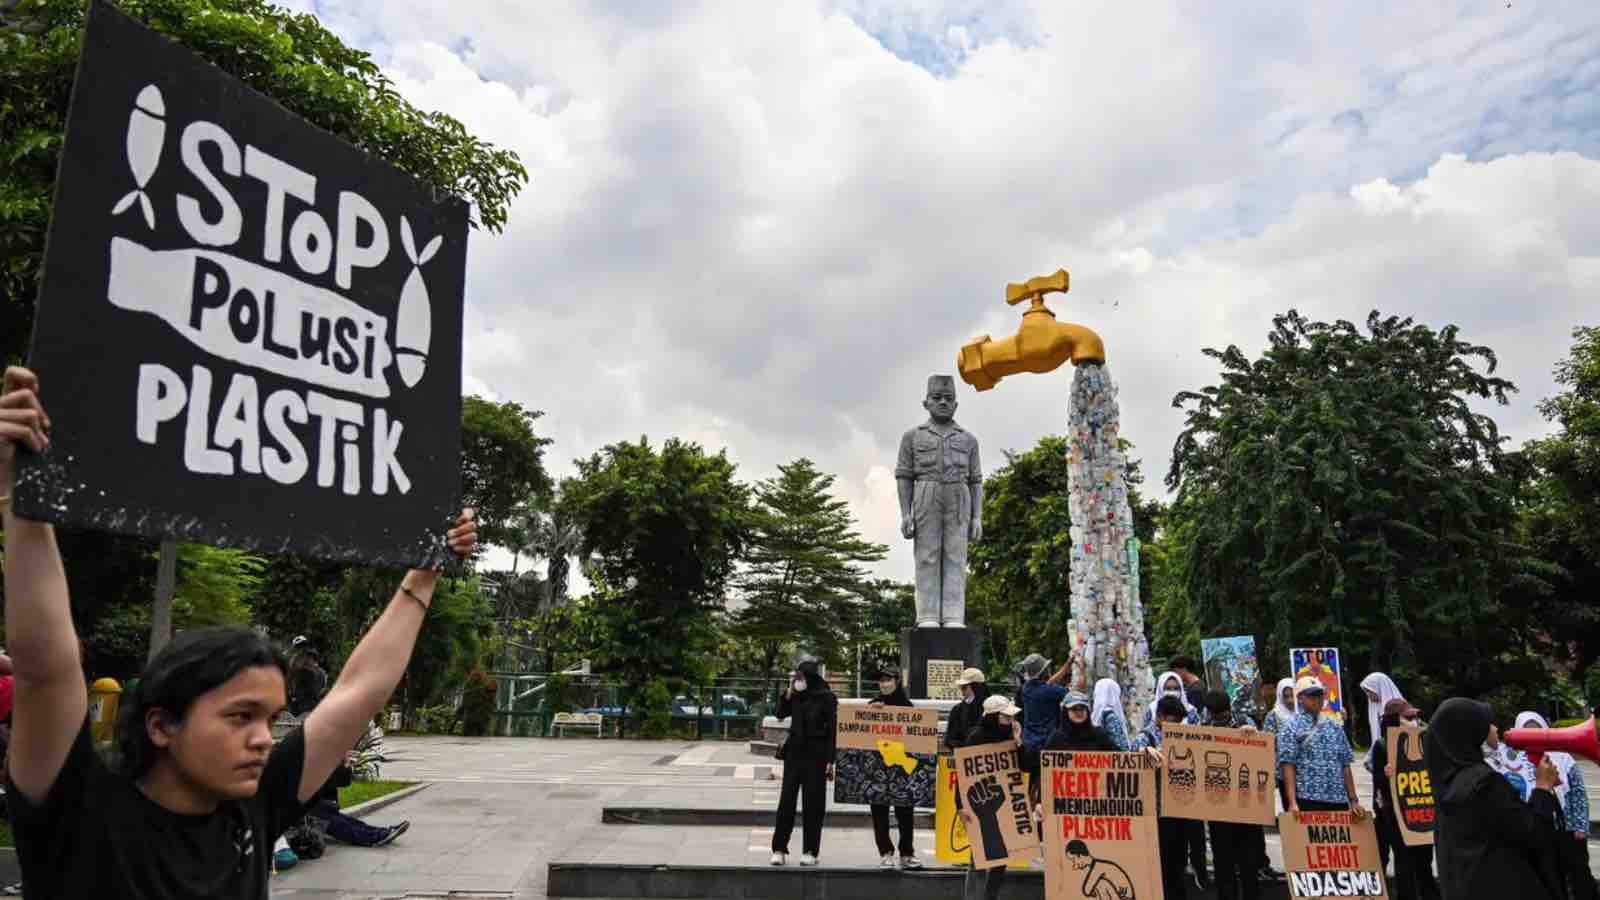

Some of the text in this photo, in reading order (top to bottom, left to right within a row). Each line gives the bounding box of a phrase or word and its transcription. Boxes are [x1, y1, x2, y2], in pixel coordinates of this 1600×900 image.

[872, 724, 903, 735] PLASTIK
[963, 751, 1018, 777] RESIST
[1042, 752, 1072, 767] STOP
[1072, 753, 1112, 768] MAKAN
[1052, 769, 1139, 798] KEAT MU
[1008, 772, 1033, 834] PLASTIC
[1053, 797, 1143, 816] MENGANDUNG
[1062, 816, 1133, 840] PLASTIK
[1307, 825, 1352, 843] MARAI
[1306, 845, 1360, 869] LEMOT
[1290, 871, 1382, 897] NDASMU
